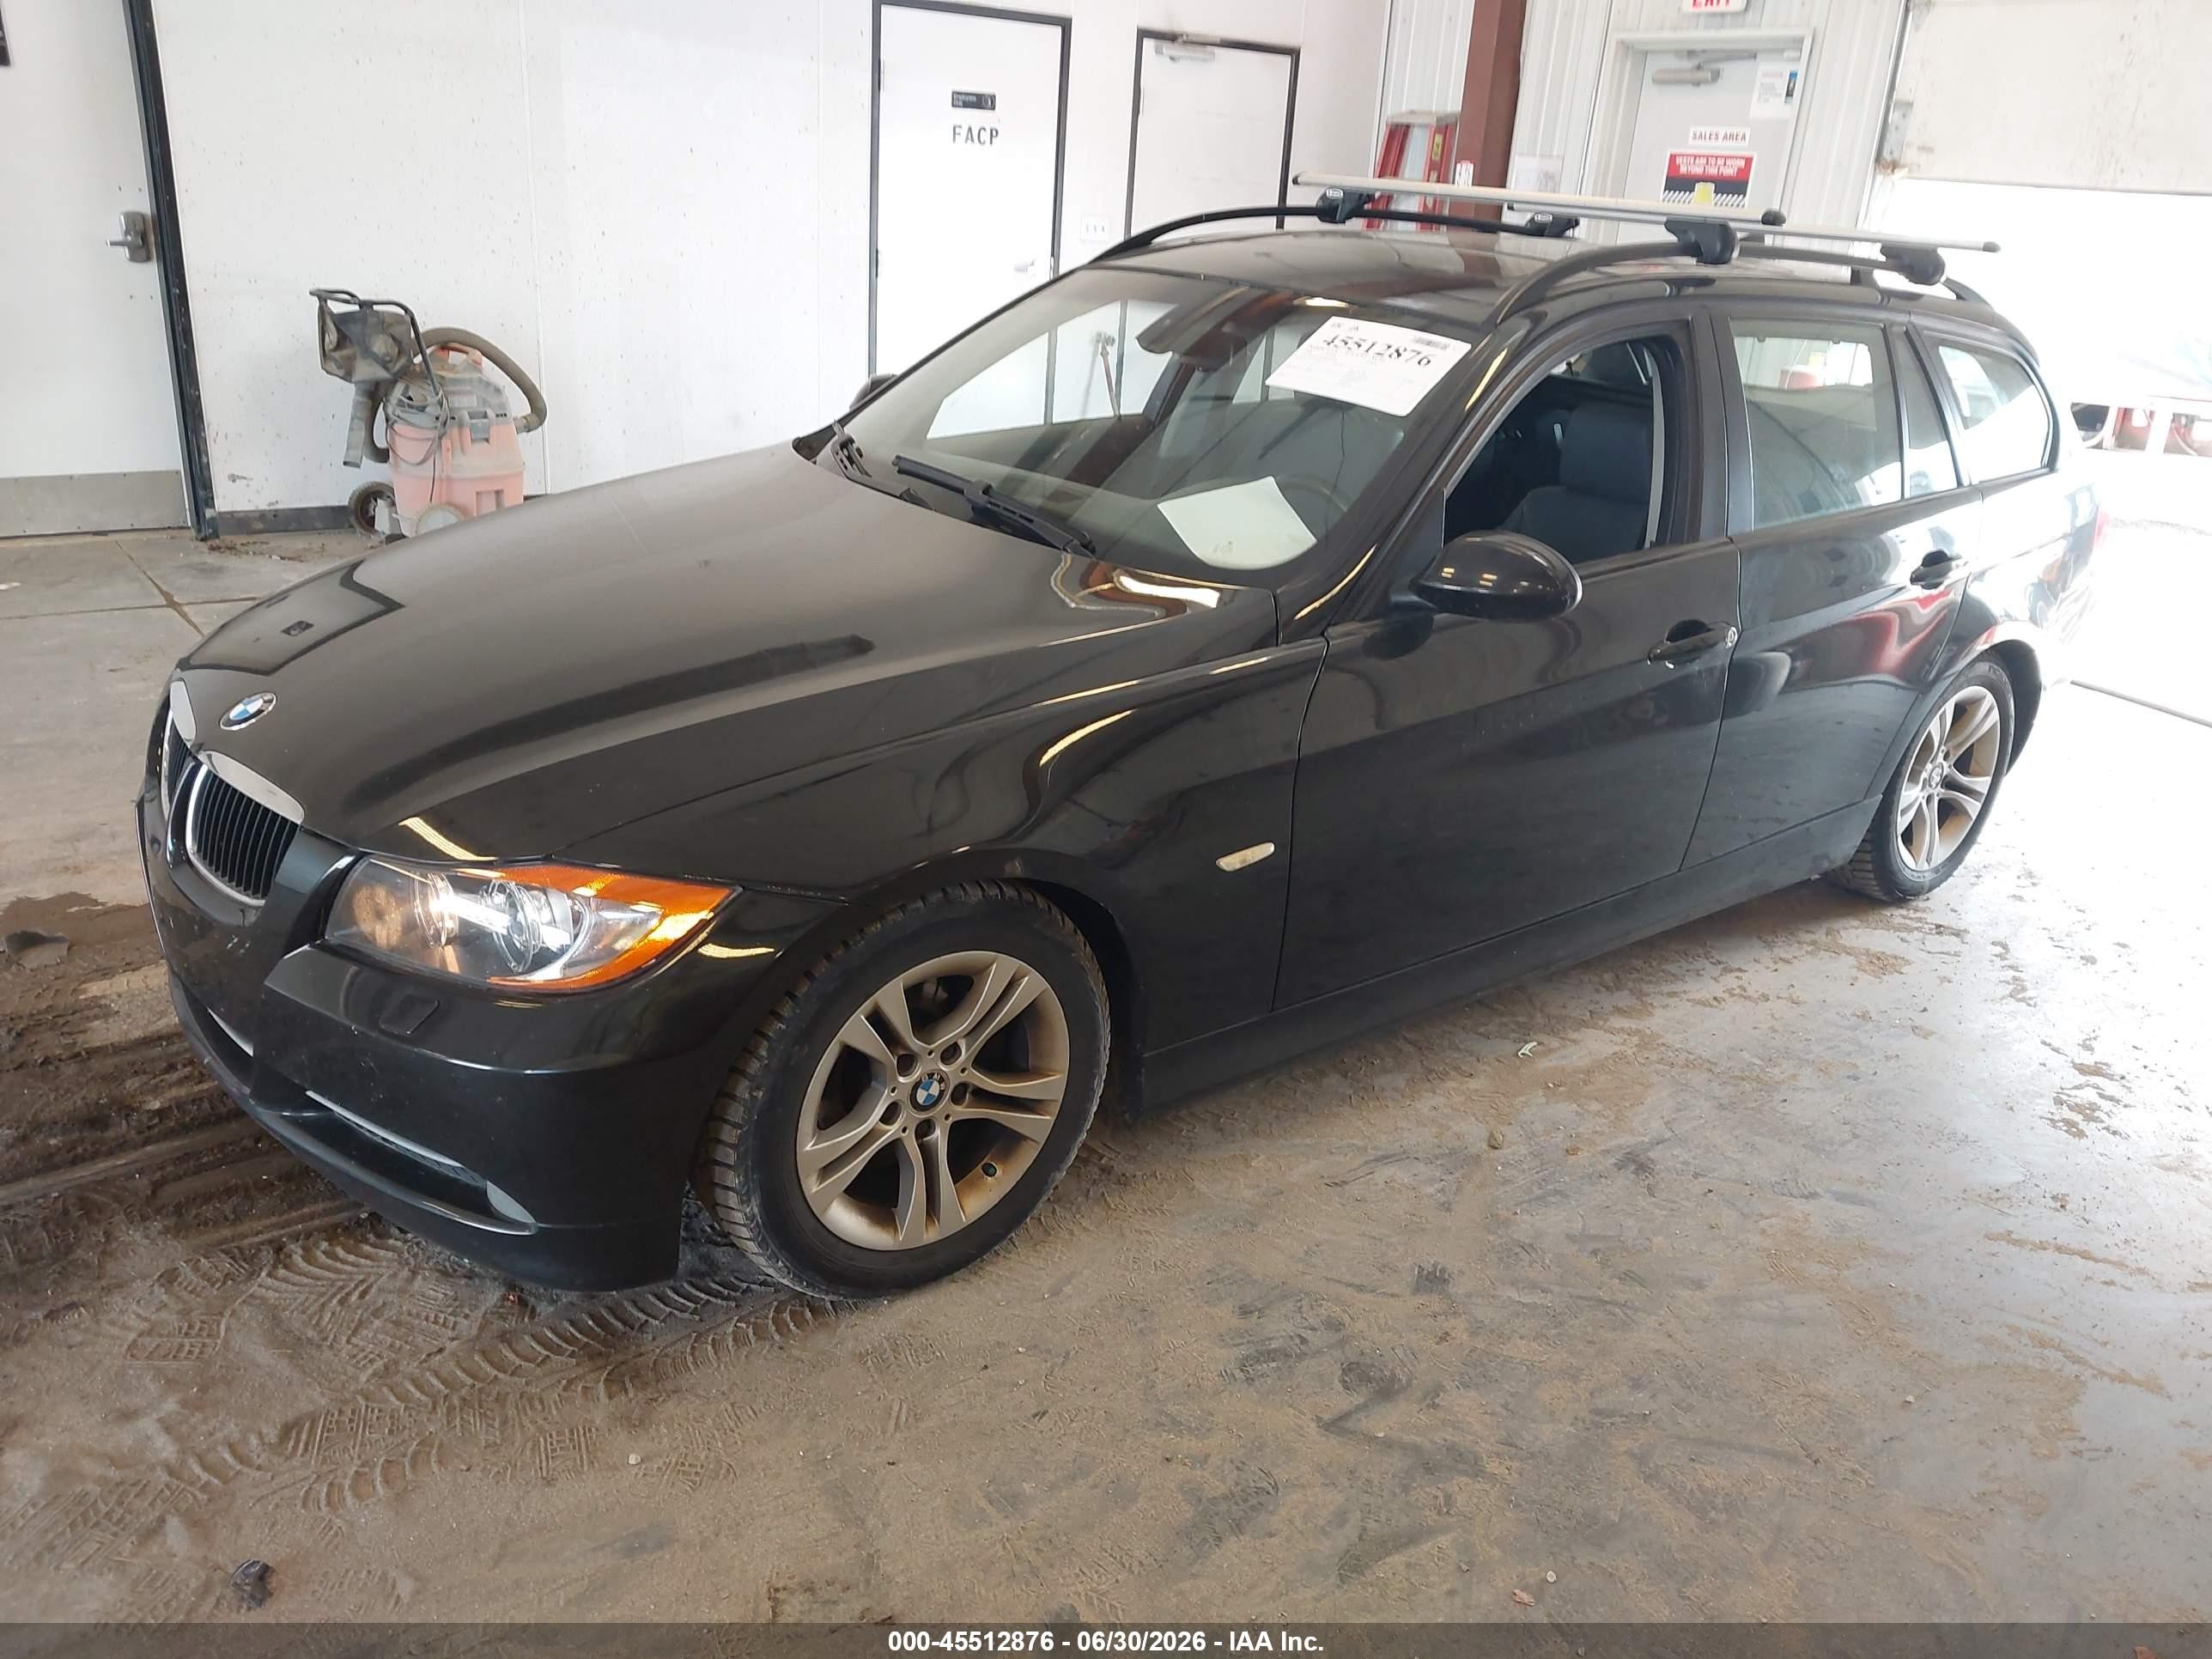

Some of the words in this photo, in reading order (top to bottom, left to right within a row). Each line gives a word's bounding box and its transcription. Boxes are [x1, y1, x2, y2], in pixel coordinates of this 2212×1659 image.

[952, 125, 1000, 145] FACP
[1692, 131, 1719, 140] SALES
[1322, 334, 1437, 367] 45512876
